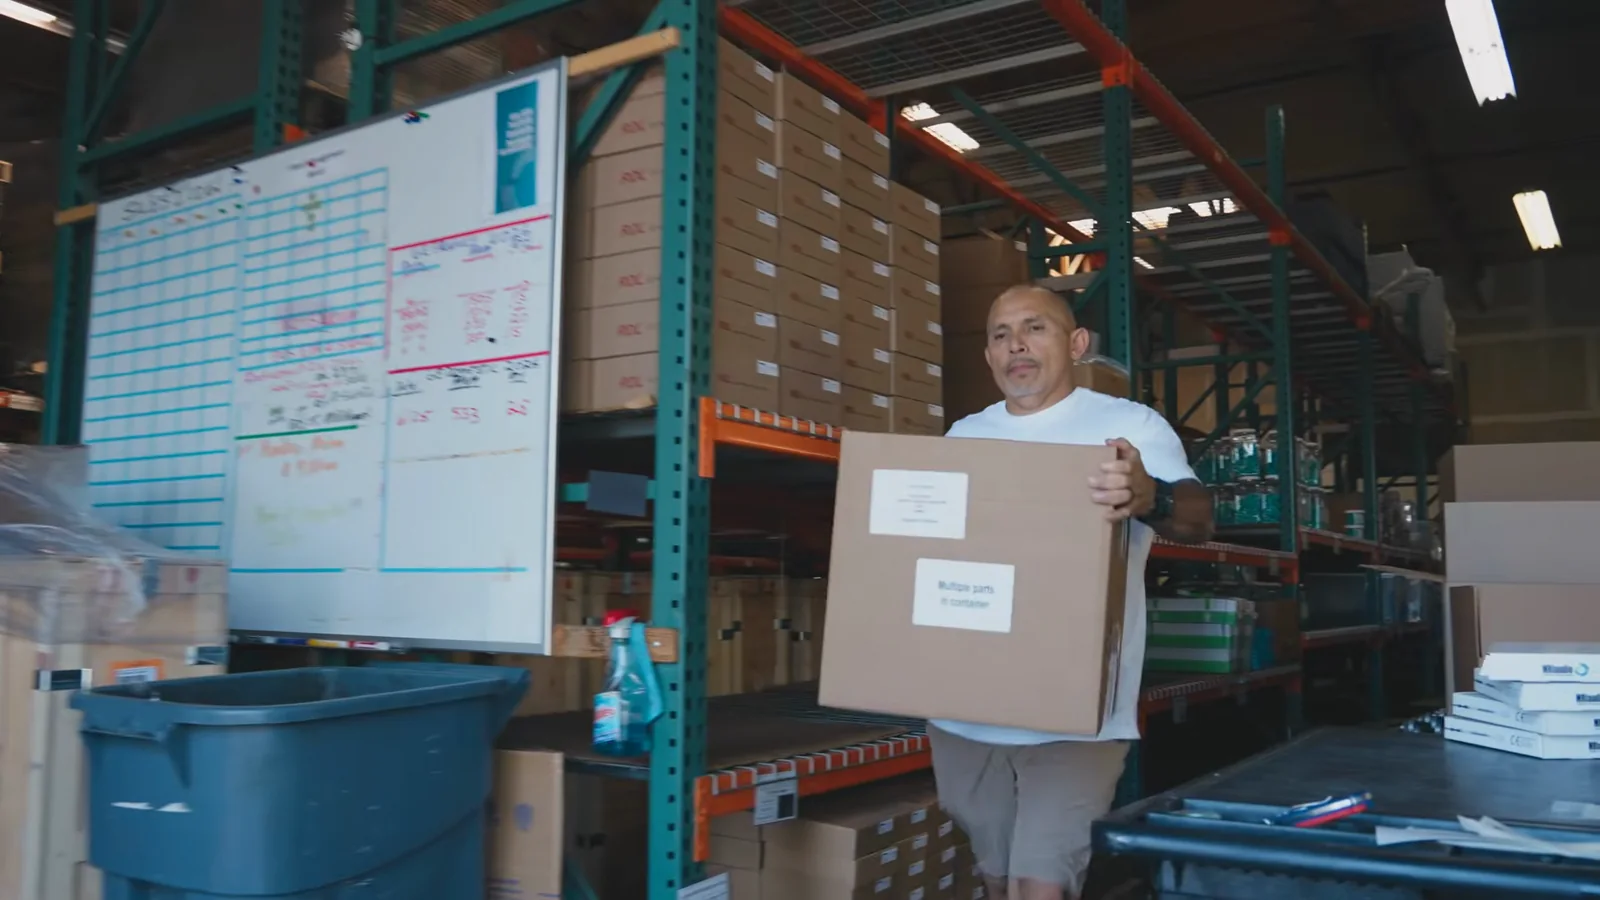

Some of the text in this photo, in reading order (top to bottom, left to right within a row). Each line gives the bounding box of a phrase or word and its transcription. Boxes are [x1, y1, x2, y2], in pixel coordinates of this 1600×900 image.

[938, 580, 995, 595] Multiple parts
[949, 599, 990, 609] container
